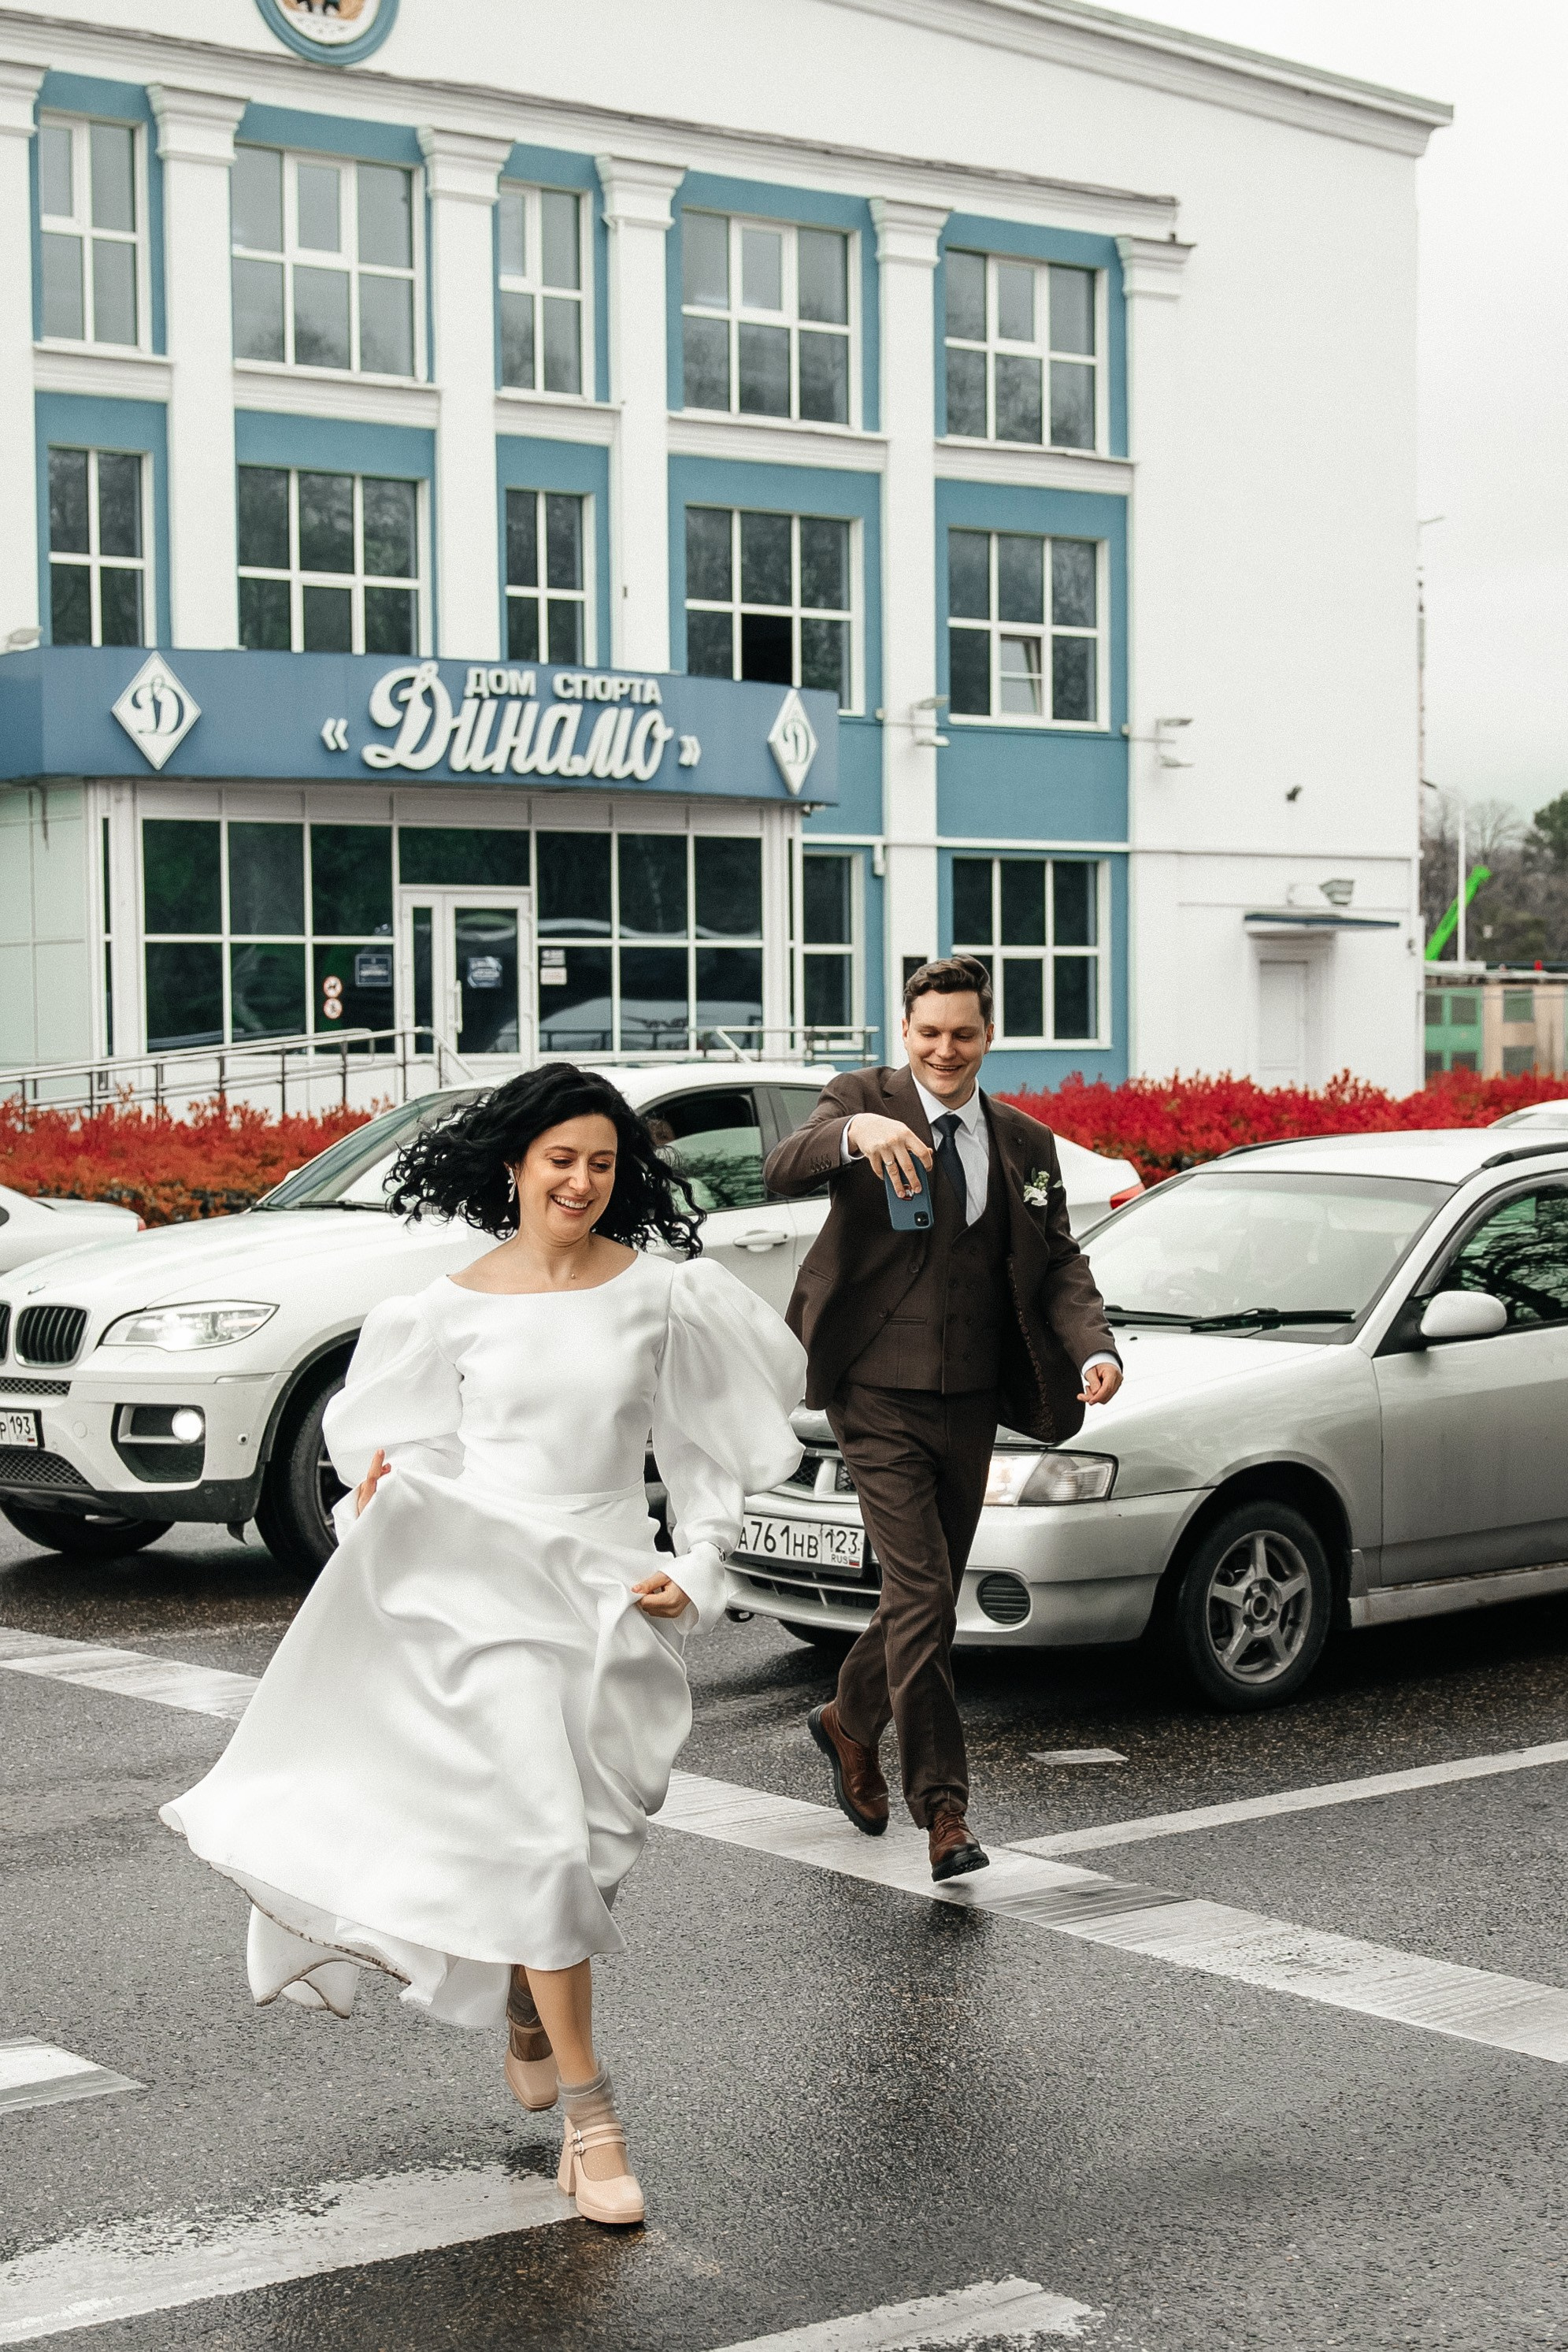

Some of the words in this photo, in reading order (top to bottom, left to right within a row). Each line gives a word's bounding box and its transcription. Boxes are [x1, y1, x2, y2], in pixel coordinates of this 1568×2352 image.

[464, 666, 537, 698] ДОМ
[553, 672, 663, 704] СПОРТА
[9, 1415, 31, 1435] 193
[825, 1529, 858, 1554] 123
[831, 1553, 848, 1564] RUS
